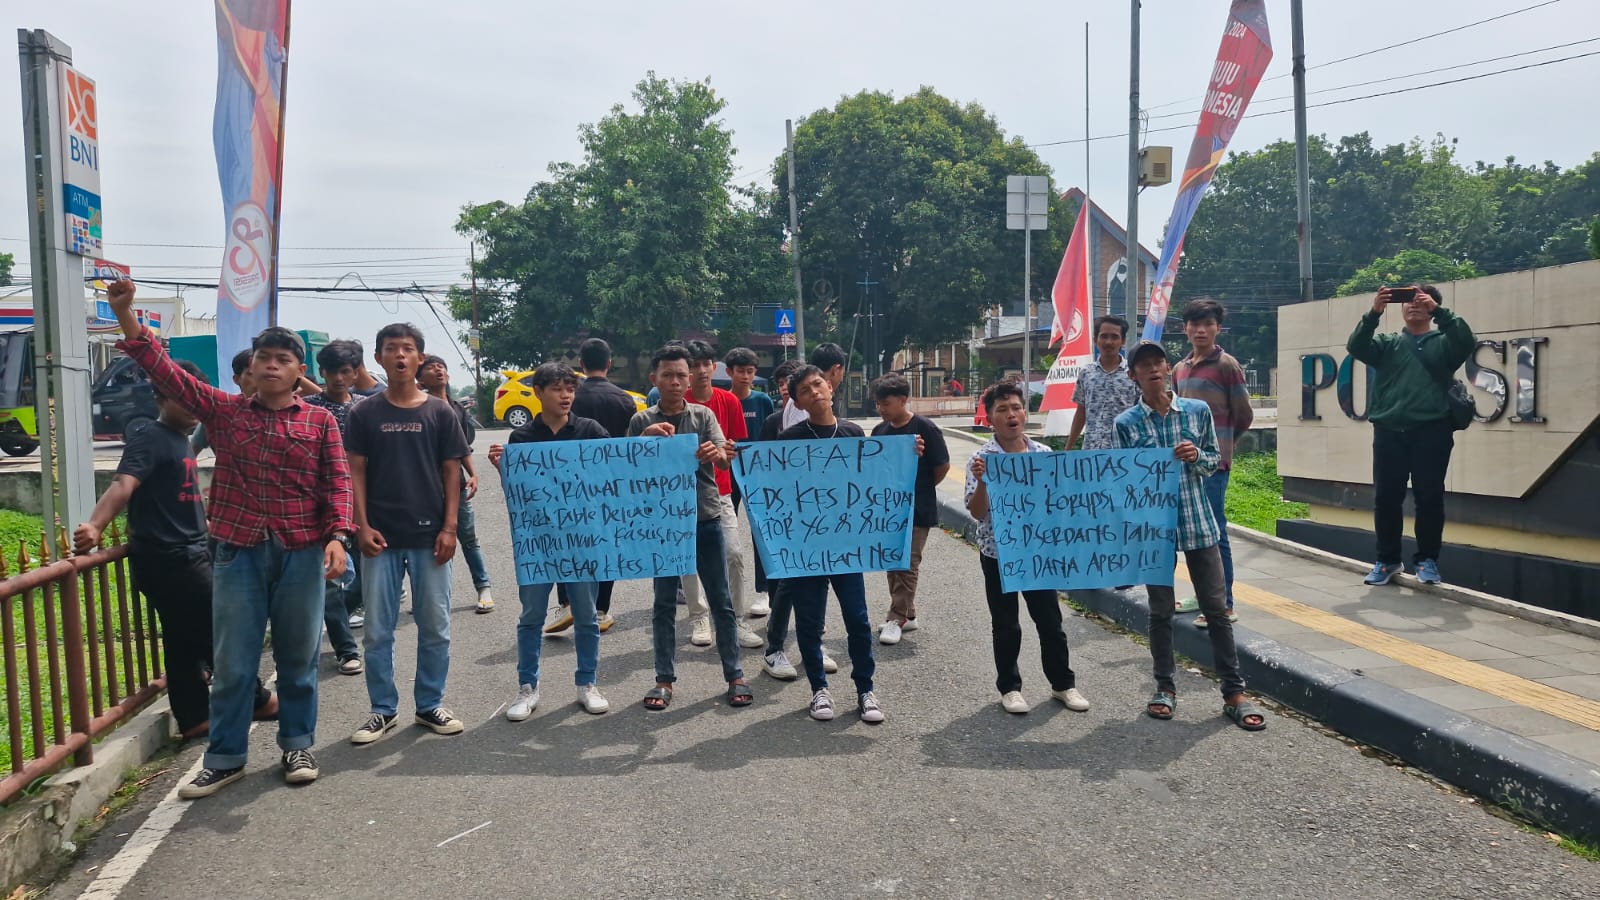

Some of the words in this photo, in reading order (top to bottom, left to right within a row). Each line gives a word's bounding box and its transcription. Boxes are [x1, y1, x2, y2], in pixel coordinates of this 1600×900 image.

[1229, 21, 1247, 39] 2024
[69, 135, 98, 171] BNI
[72, 192, 89, 208] ATM
